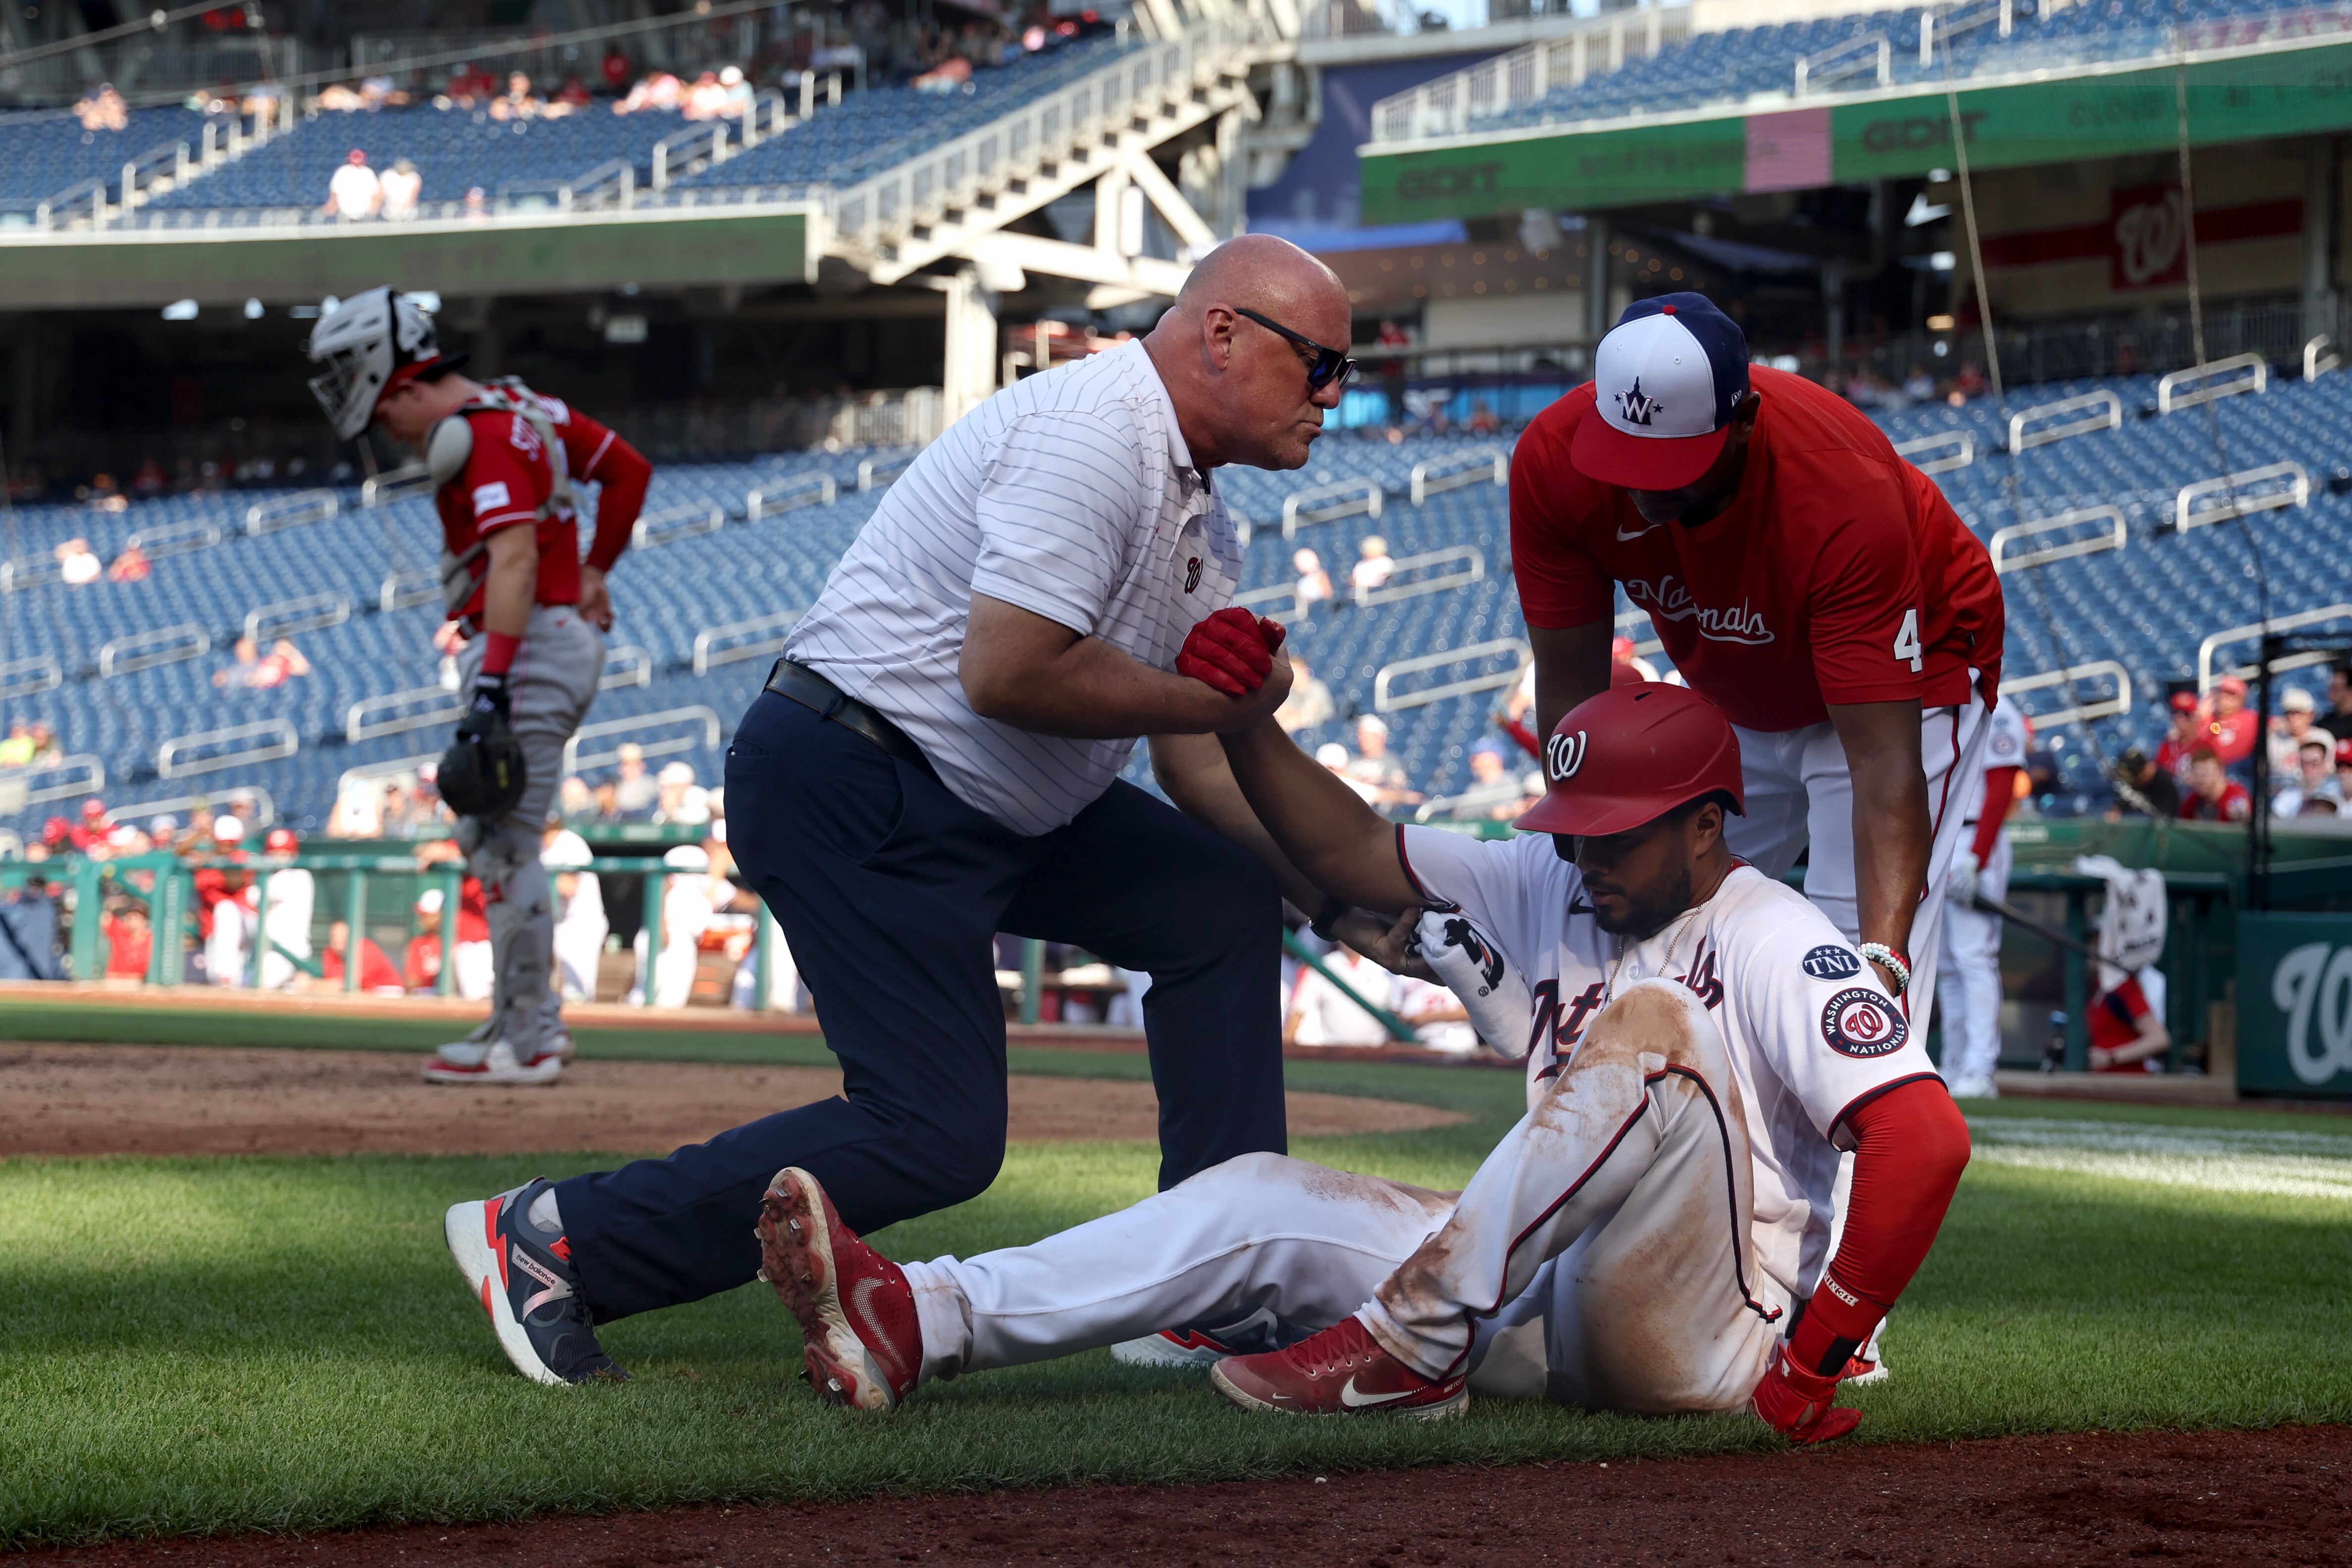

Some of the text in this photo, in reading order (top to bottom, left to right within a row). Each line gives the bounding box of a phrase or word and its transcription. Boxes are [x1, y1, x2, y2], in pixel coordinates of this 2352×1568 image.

[1622, 391, 1653, 423] W
[1184, 557, 1203, 594] W
[1627, 575, 1775, 645] Nanals
[1893, 608, 1922, 673] 4
[1547, 730, 1587, 782] W
[1805, 955, 1860, 976] TNL
[1825, 990, 1888, 1035] WASHINGTON
[1845, 1004, 1883, 1039] W
[1849, 1023, 1905, 1054] NATIONALS
[516, 1254, 556, 1285] new balance
